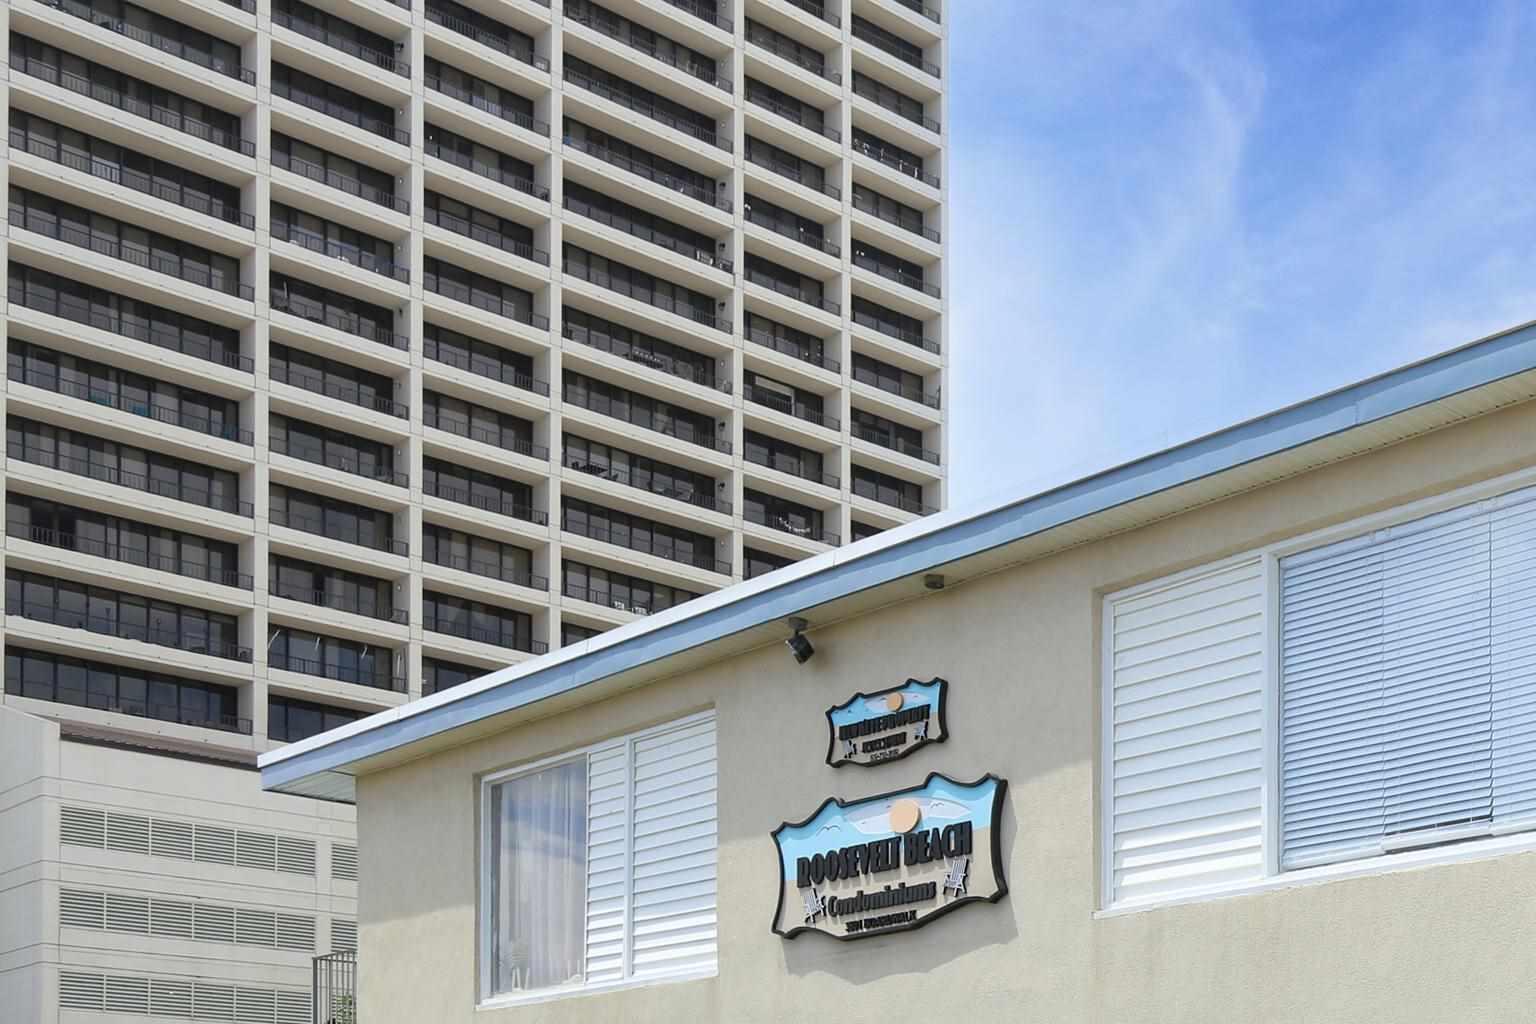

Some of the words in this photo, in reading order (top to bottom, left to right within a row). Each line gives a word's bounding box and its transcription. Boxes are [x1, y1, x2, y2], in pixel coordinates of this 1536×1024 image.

[797, 836, 902, 888] ROOSEVELT
[904, 820, 973, 866] BEACH
[827, 881, 938, 917] Condominiums
